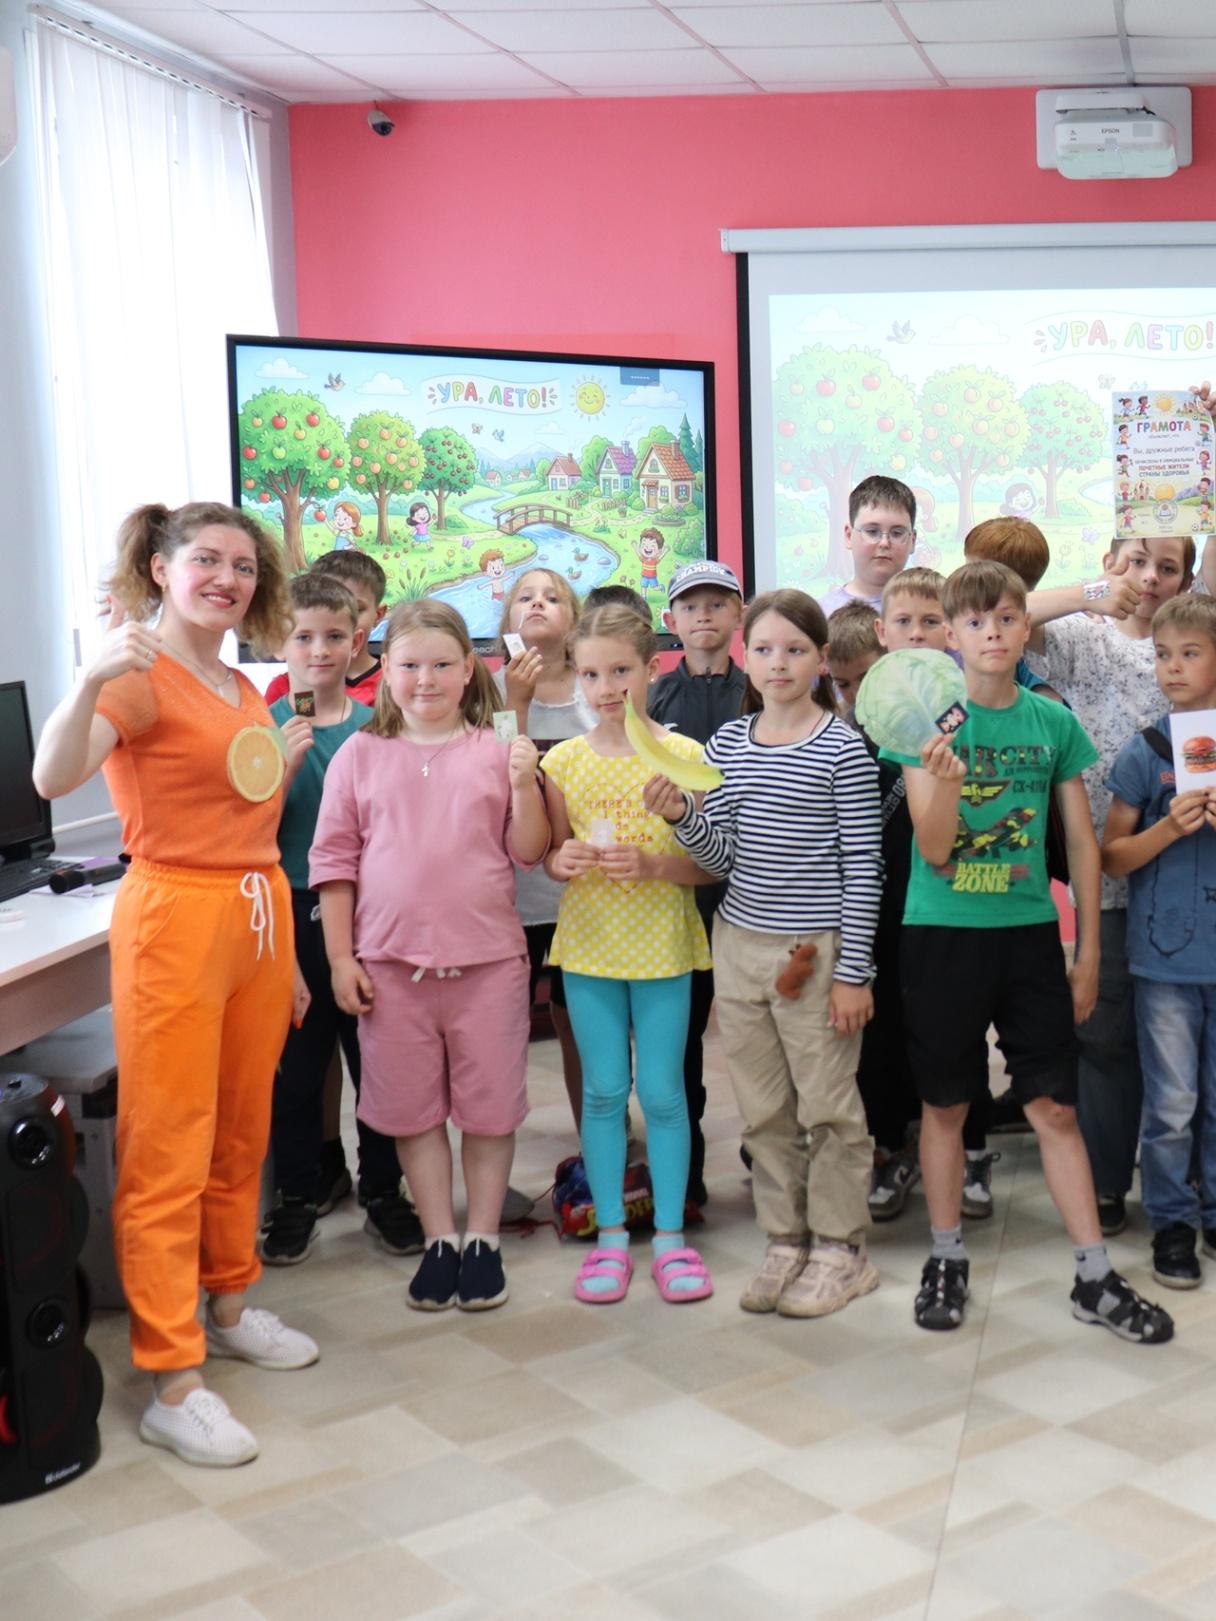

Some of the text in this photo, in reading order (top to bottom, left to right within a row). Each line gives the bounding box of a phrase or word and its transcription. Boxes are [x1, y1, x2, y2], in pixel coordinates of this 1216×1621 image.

[1048, 319, 1214, 351] УРА, ЛЕТО!
[437, 381, 548, 408] УРА, ЛЕТО!
[1137, 420, 1192, 433] ГРАМОТА
[956, 862, 1011, 874] BATTLE
[952, 872, 1009, 893] ZONE
